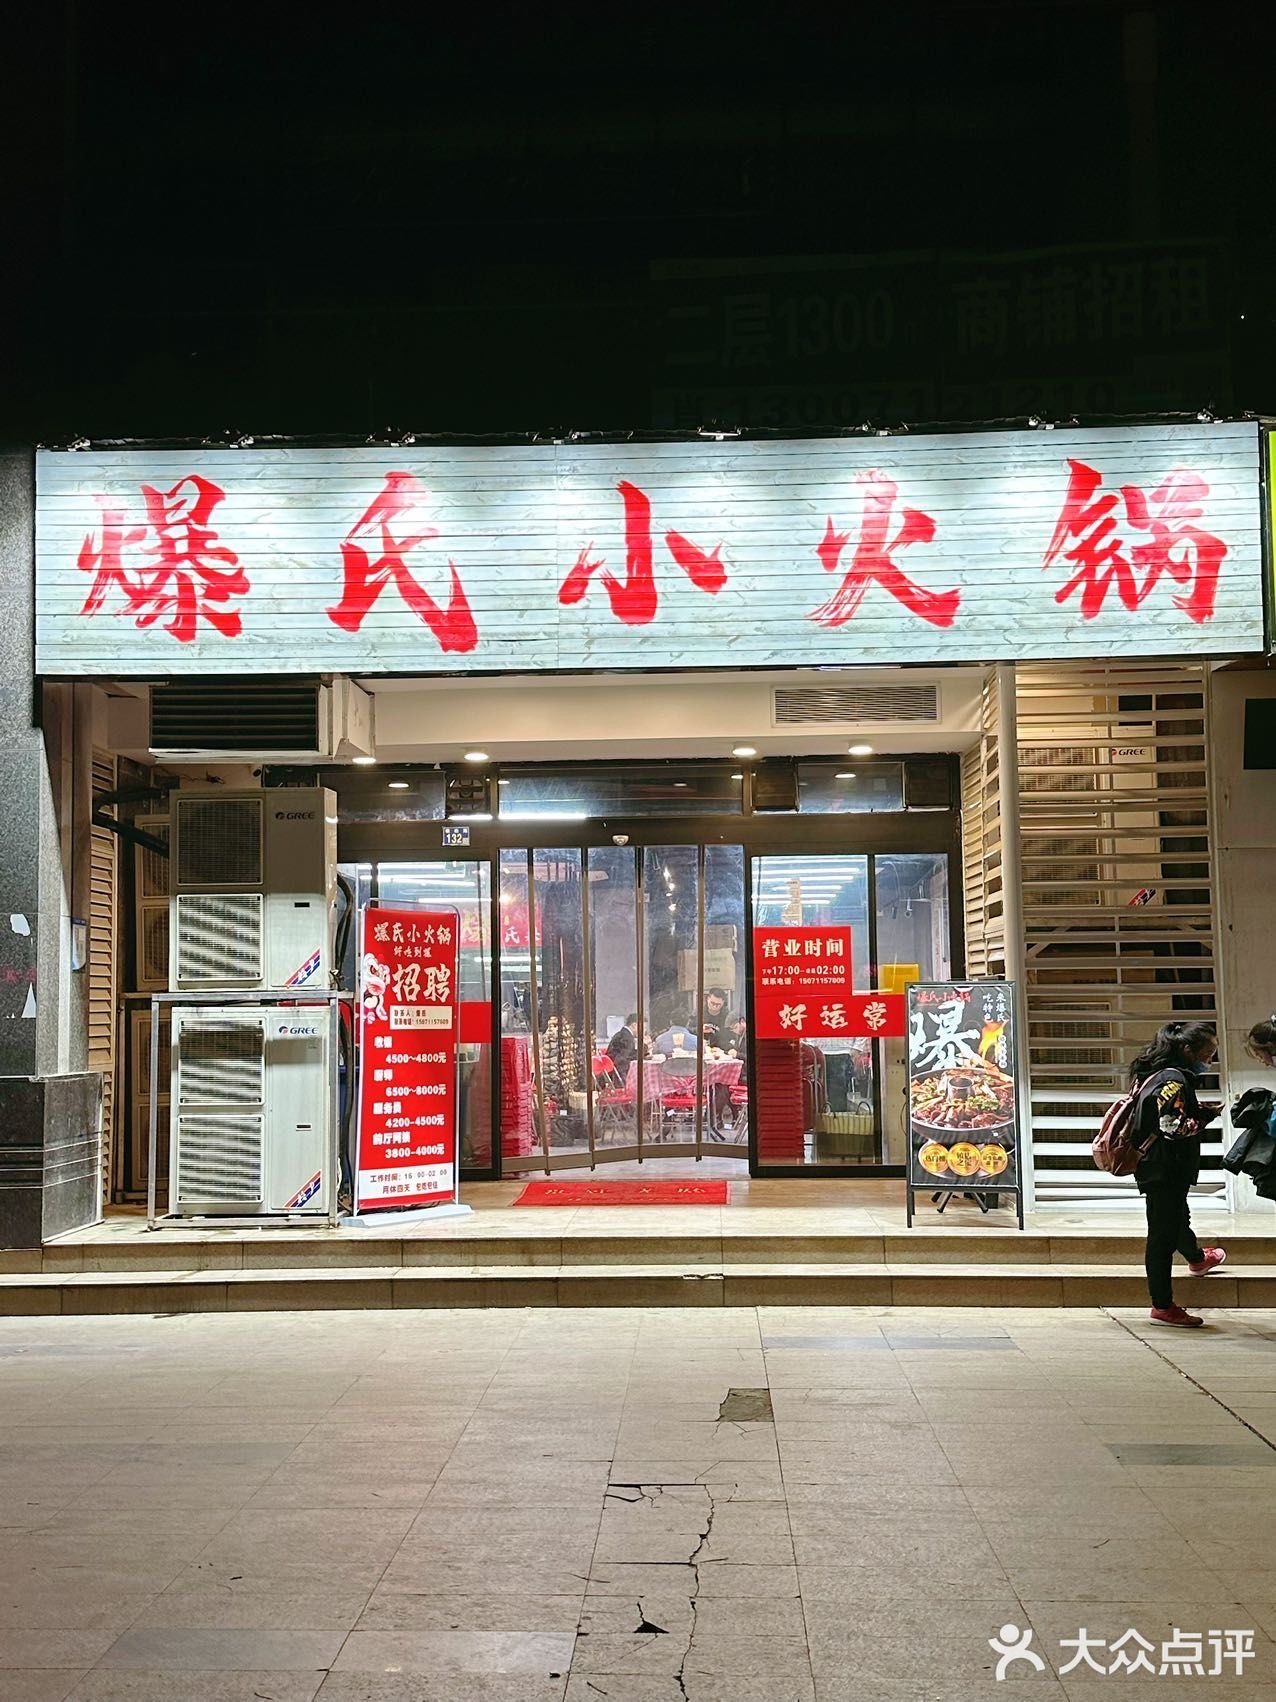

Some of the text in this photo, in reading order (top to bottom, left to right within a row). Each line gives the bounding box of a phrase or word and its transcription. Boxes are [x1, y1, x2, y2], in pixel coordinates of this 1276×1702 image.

[77, 457, 1227, 653] 爆氏小火锅
[1118, 748, 1147, 756] GREE
[286, 811, 316, 820] GREE
[761, 938, 844, 958] 营业时间
[392, 962, 451, 1003] 招聘
[372, 1101, 402, 1115] 服务员
